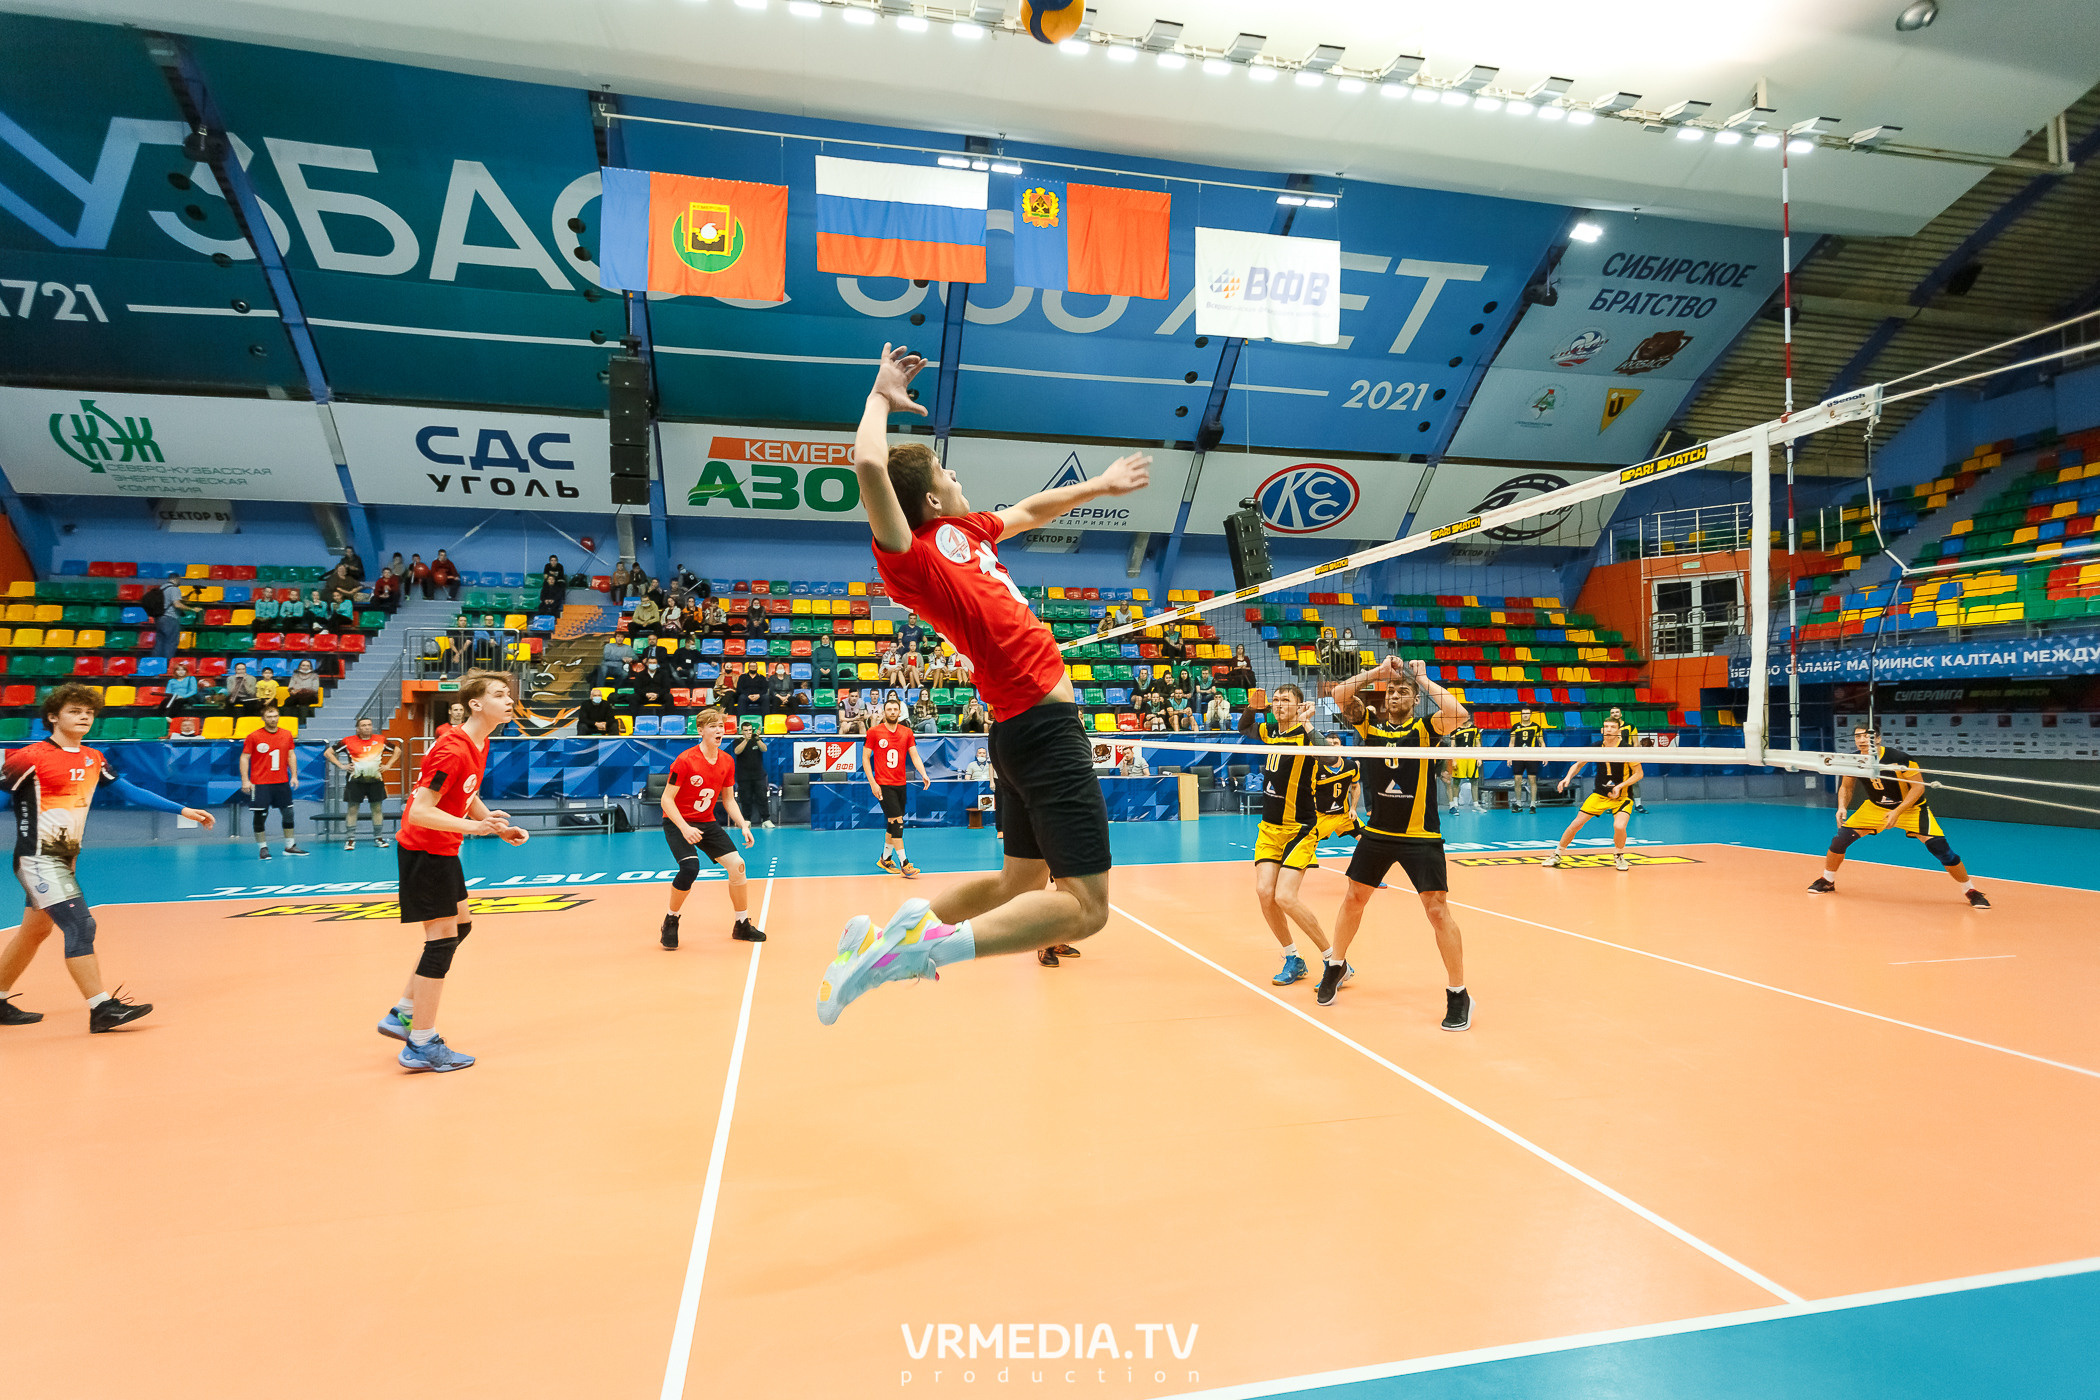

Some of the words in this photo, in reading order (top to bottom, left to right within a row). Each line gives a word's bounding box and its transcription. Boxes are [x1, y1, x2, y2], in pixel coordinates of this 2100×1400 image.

[1602, 252, 1757, 288] СИБИРСКОЕ
[1244, 266, 1330, 307] ВФВ
[1588, 288, 1717, 319] БРАТСТВО
[1342, 379, 1430, 411] 2021
[415, 425, 576, 473] СДС
[1656, 446, 1708, 472] MATCH
[106, 463, 272, 476] СЕВЕРО-КУЗБАССКАЯ
[113, 474, 248, 485] ЭНЕРГЕТИЧЕСКАЯ
[427, 473, 580, 499] УГОЛЬ
[117, 484, 203, 494] КОМПАНИЯ
[159, 510, 210, 522] СЕКТОР
[1051, 519, 1128, 527] РЕДПРИЯТИЙ
[1451, 517, 1481, 534] MATCH
[1026, 534, 1064, 543] СЕКТОР
[1847, 656, 1934, 671] МАРИИНСК
[1941, 652, 2016, 667] КАЛТАН
[1895, 689, 1964, 701] СУПЕРЛИГА
[1522, 731, 1528, 741] 9
[269, 749, 280, 771] 1
[886, 748, 898, 769] 9
[69, 768, 86, 782] 12
[1333, 782, 1342, 798] 6
[693, 788, 715, 812] 3
[489, 871, 607, 887] ЛЕТ
